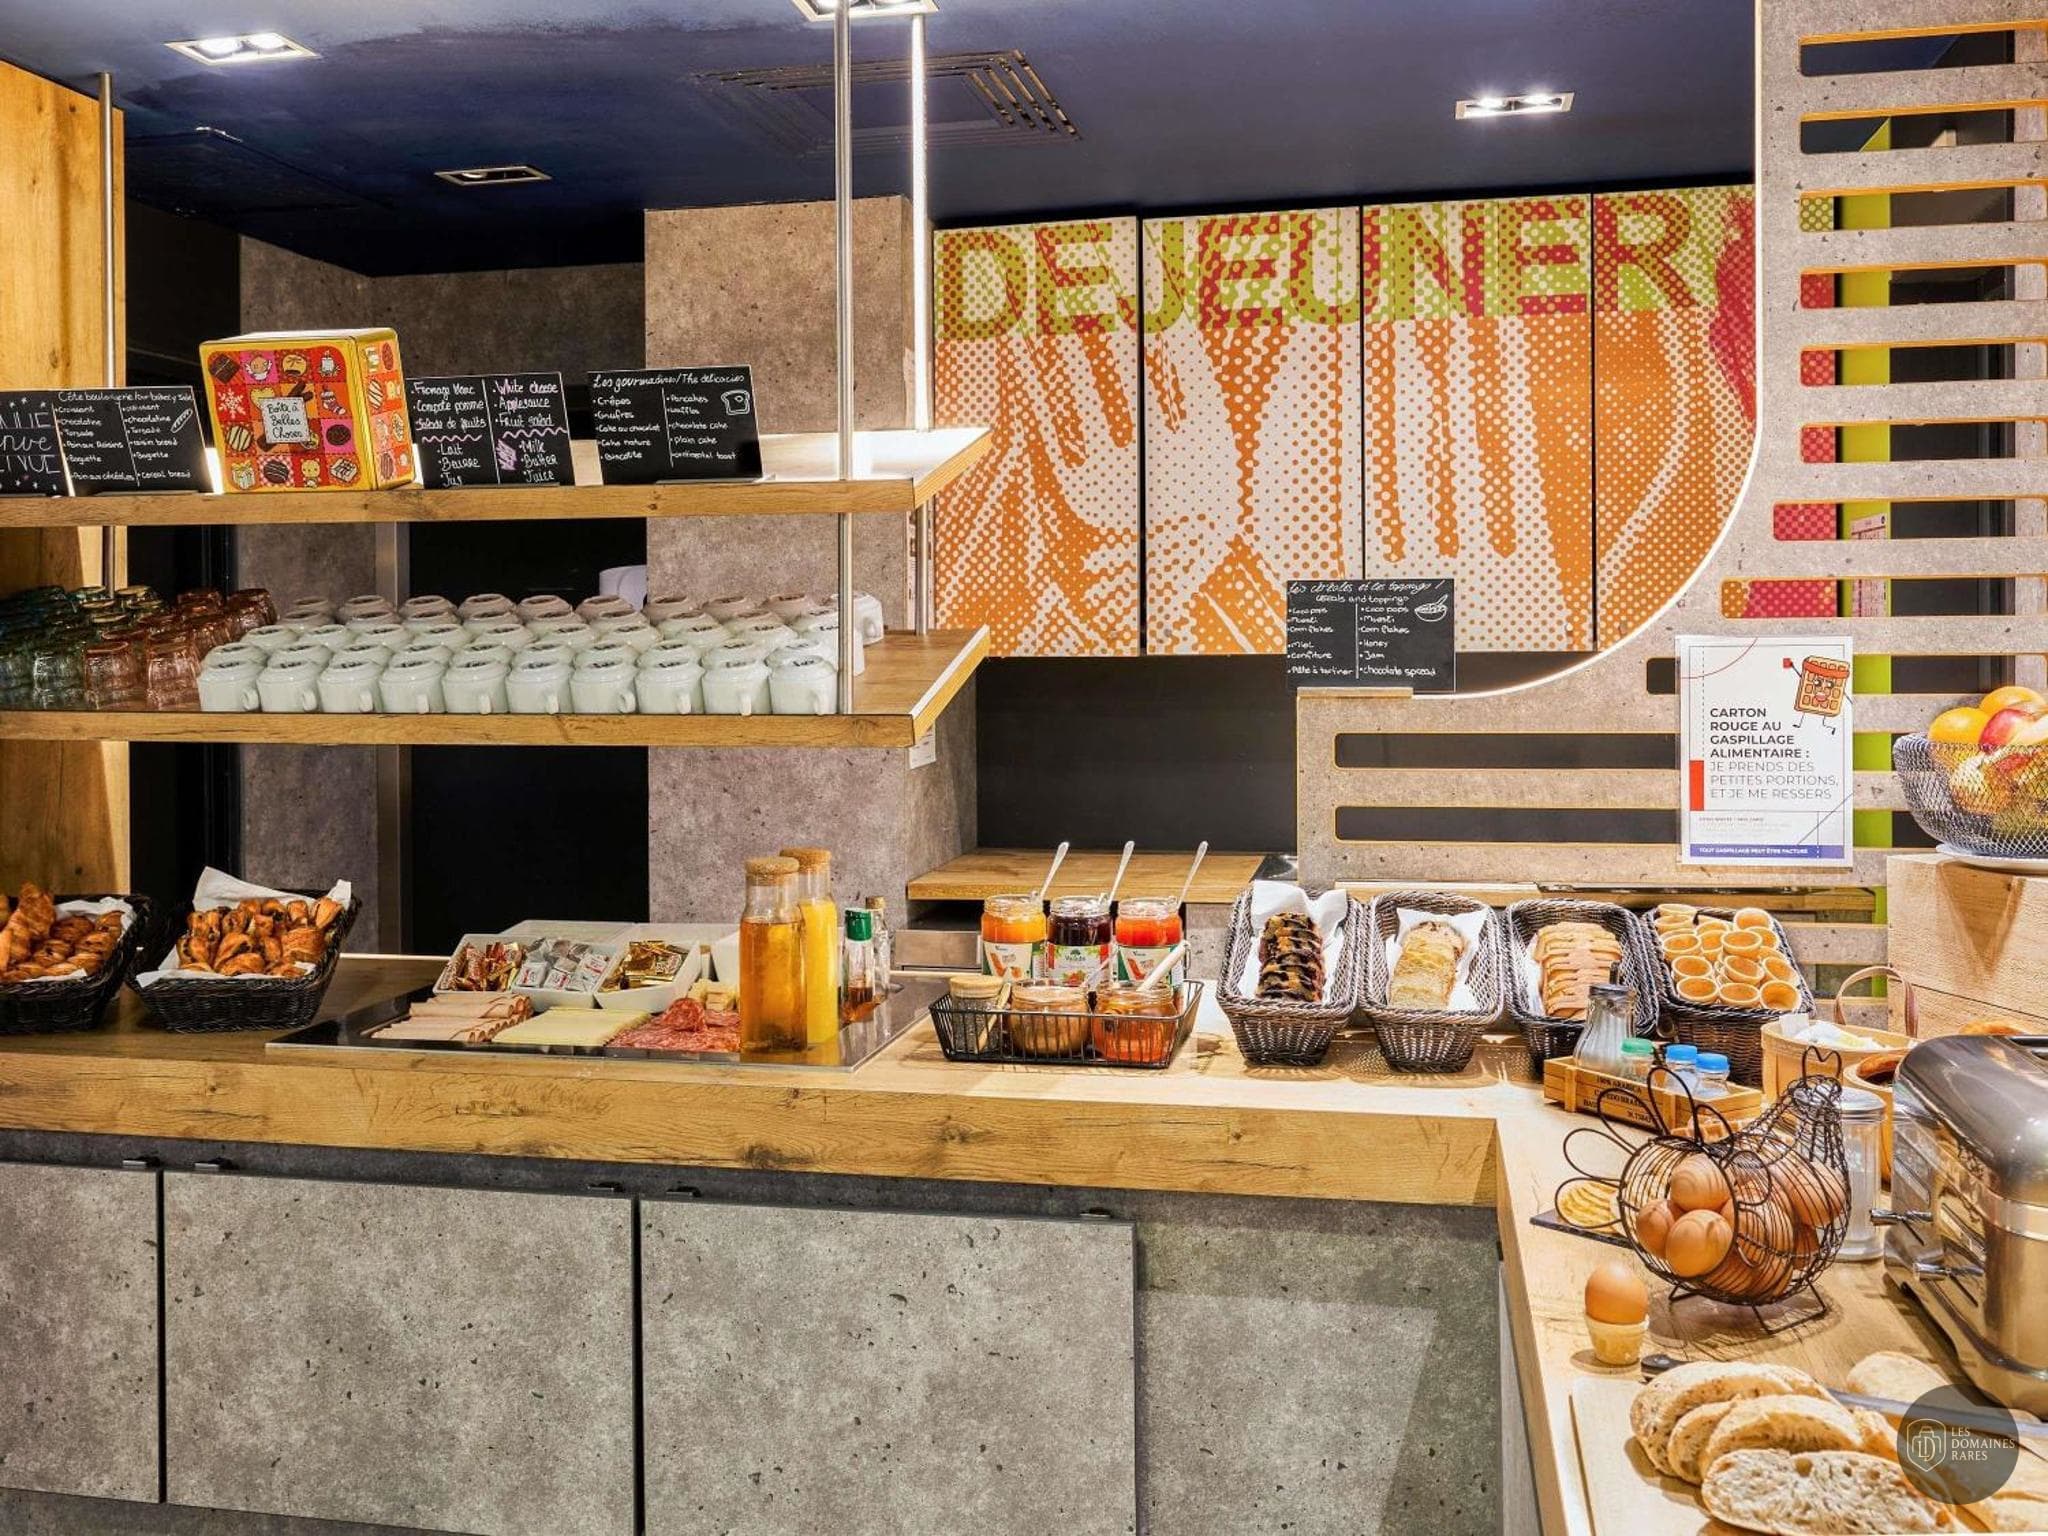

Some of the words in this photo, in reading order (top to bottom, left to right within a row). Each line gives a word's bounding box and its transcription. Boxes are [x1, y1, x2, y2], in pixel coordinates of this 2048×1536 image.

[597, 395, 631, 407] Crêpes
[1710, 708, 1766, 718] CARTON
[1710, 721, 1758, 731] ROUGE
[1762, 721, 1781, 731] AU
[1710, 735, 1795, 745] GASPILLAGE
[1710, 748, 1802, 758] ALIMENTAIRE
[1710, 761, 1724, 772] JE
[1728, 761, 1783, 772] PRENDS
[1787, 761, 1814, 772] DES
[1710, 775, 1762, 785] PETITES
[1748, 788, 1769, 799] ME
[1772, 788, 1833, 799] RESSERS
